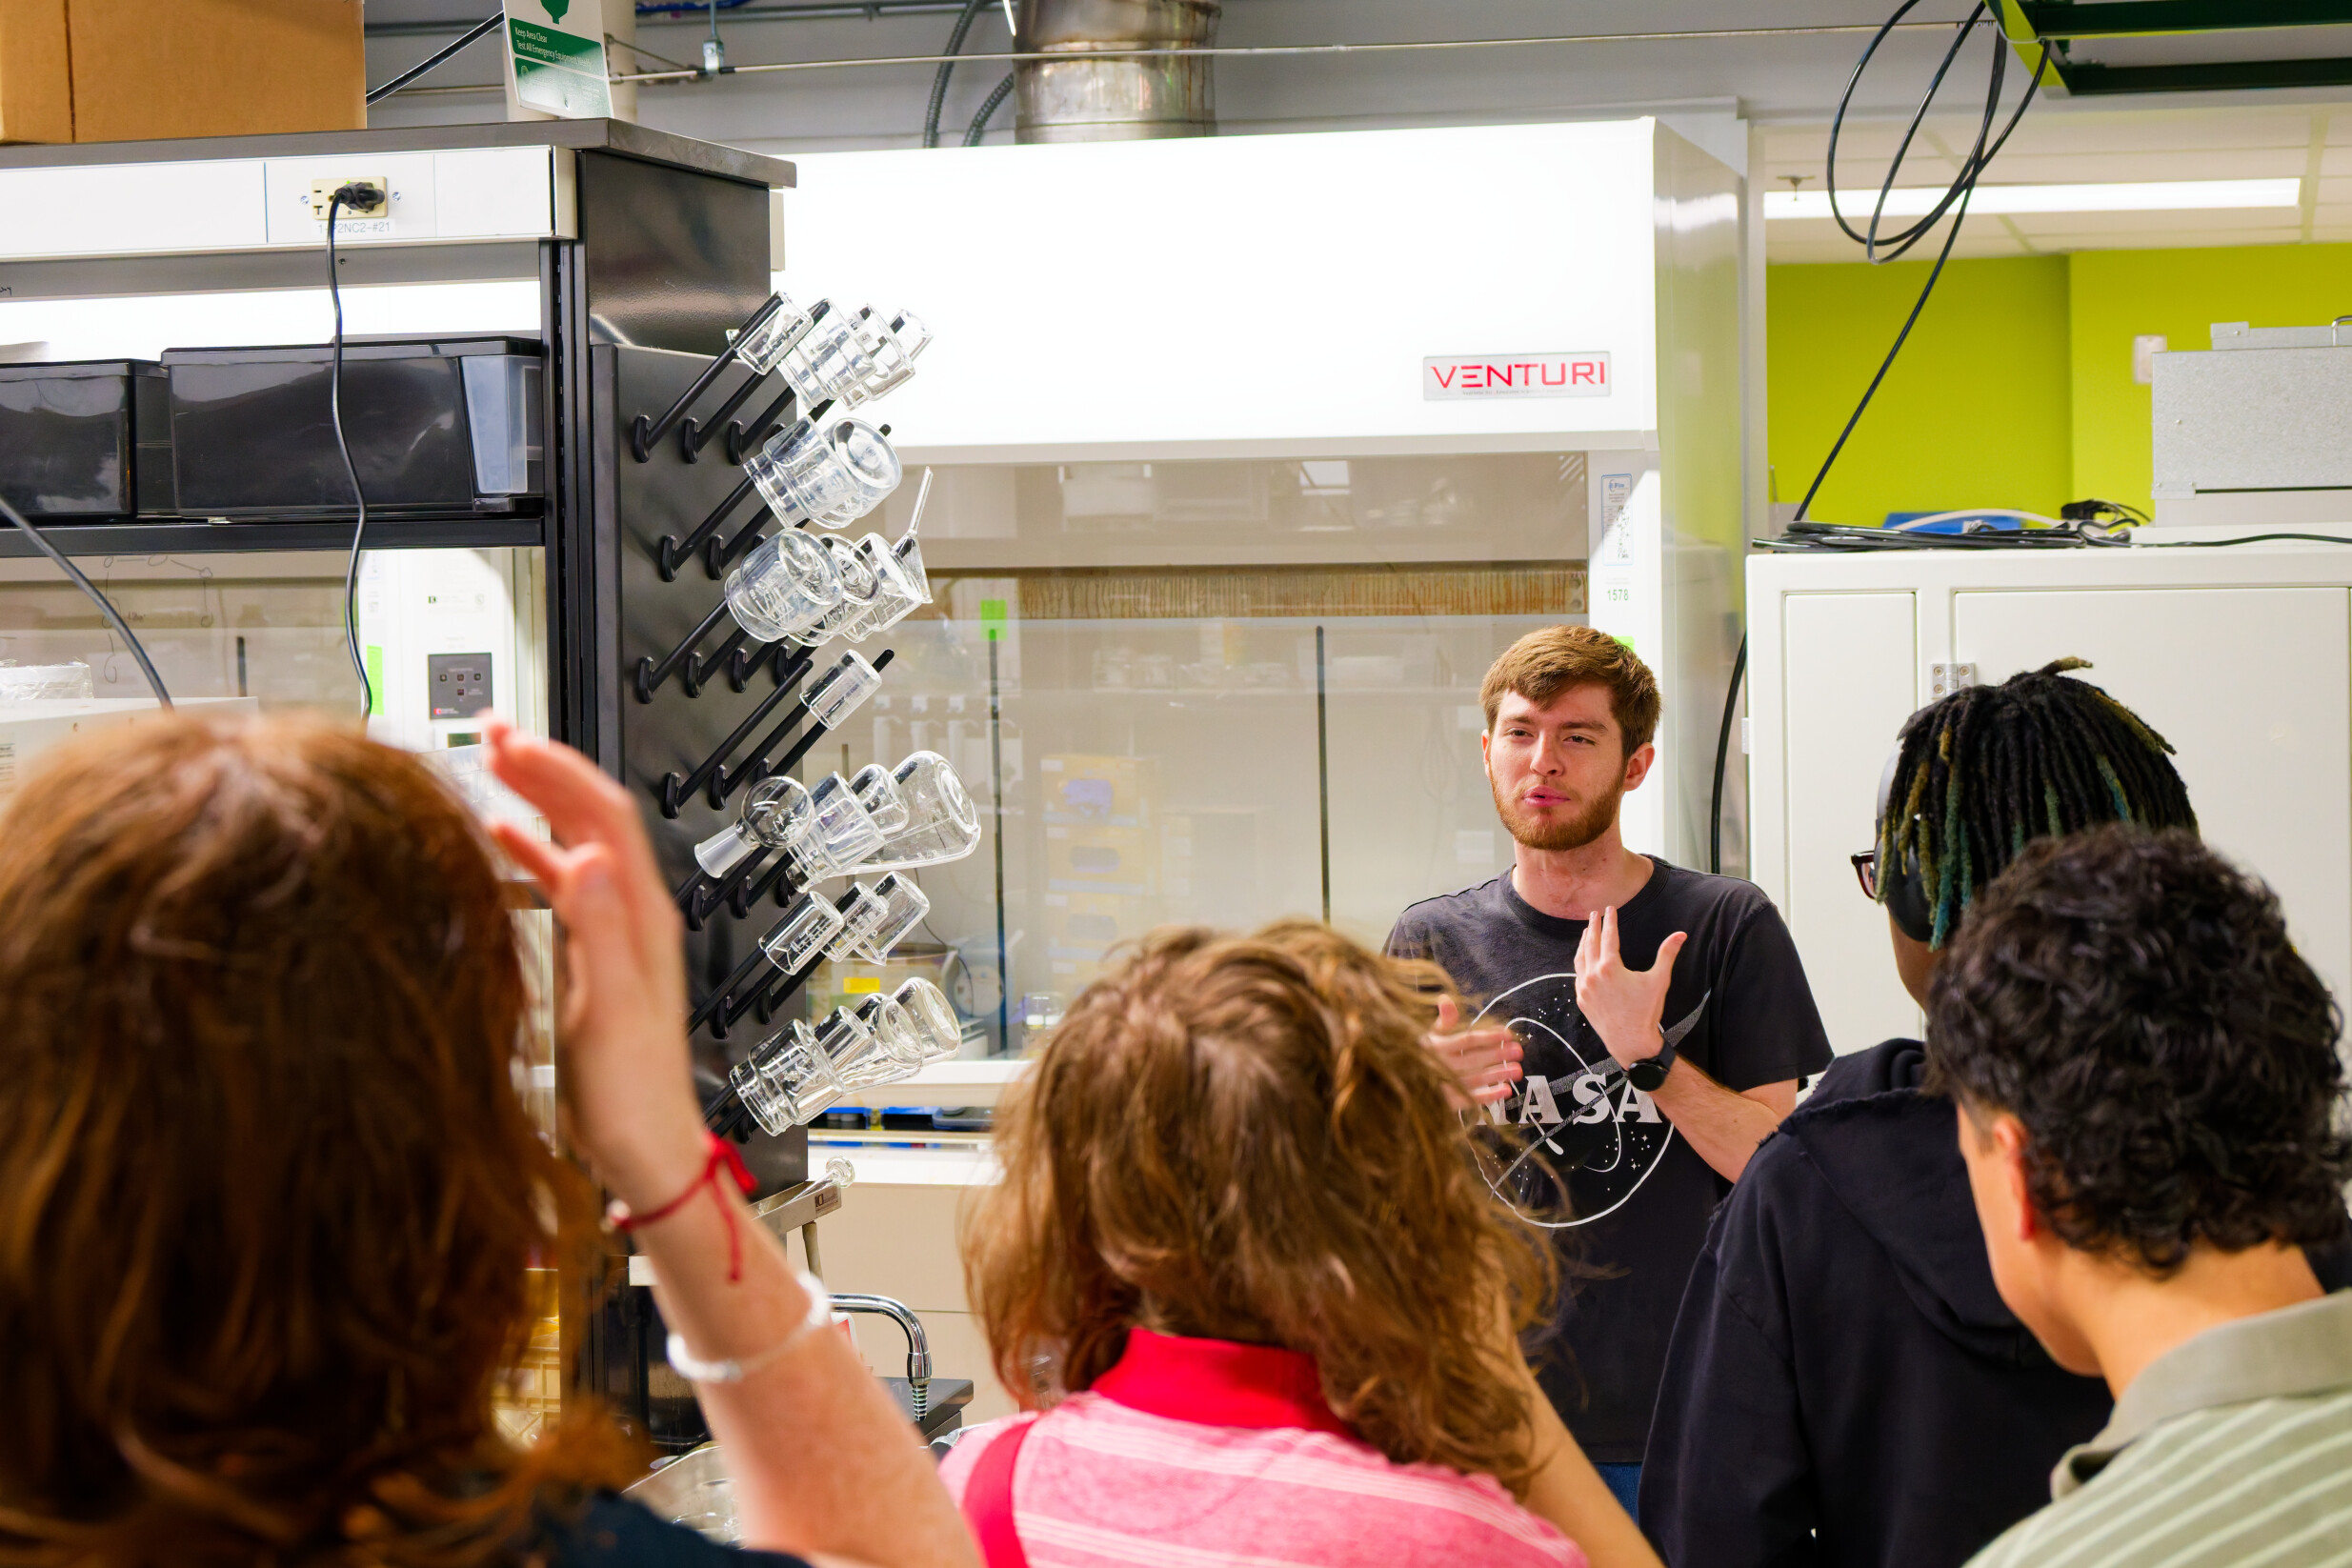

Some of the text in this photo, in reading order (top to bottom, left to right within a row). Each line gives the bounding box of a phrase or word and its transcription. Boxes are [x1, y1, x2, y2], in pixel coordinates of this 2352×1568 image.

[514, 27, 548, 43] Keep Area Clear
[516, 39, 526, 50] Test
[532, 44, 554, 60] Emergency
[1430, 361, 1605, 389] VENTURI
[1607, 589, 1629, 601] 1578
